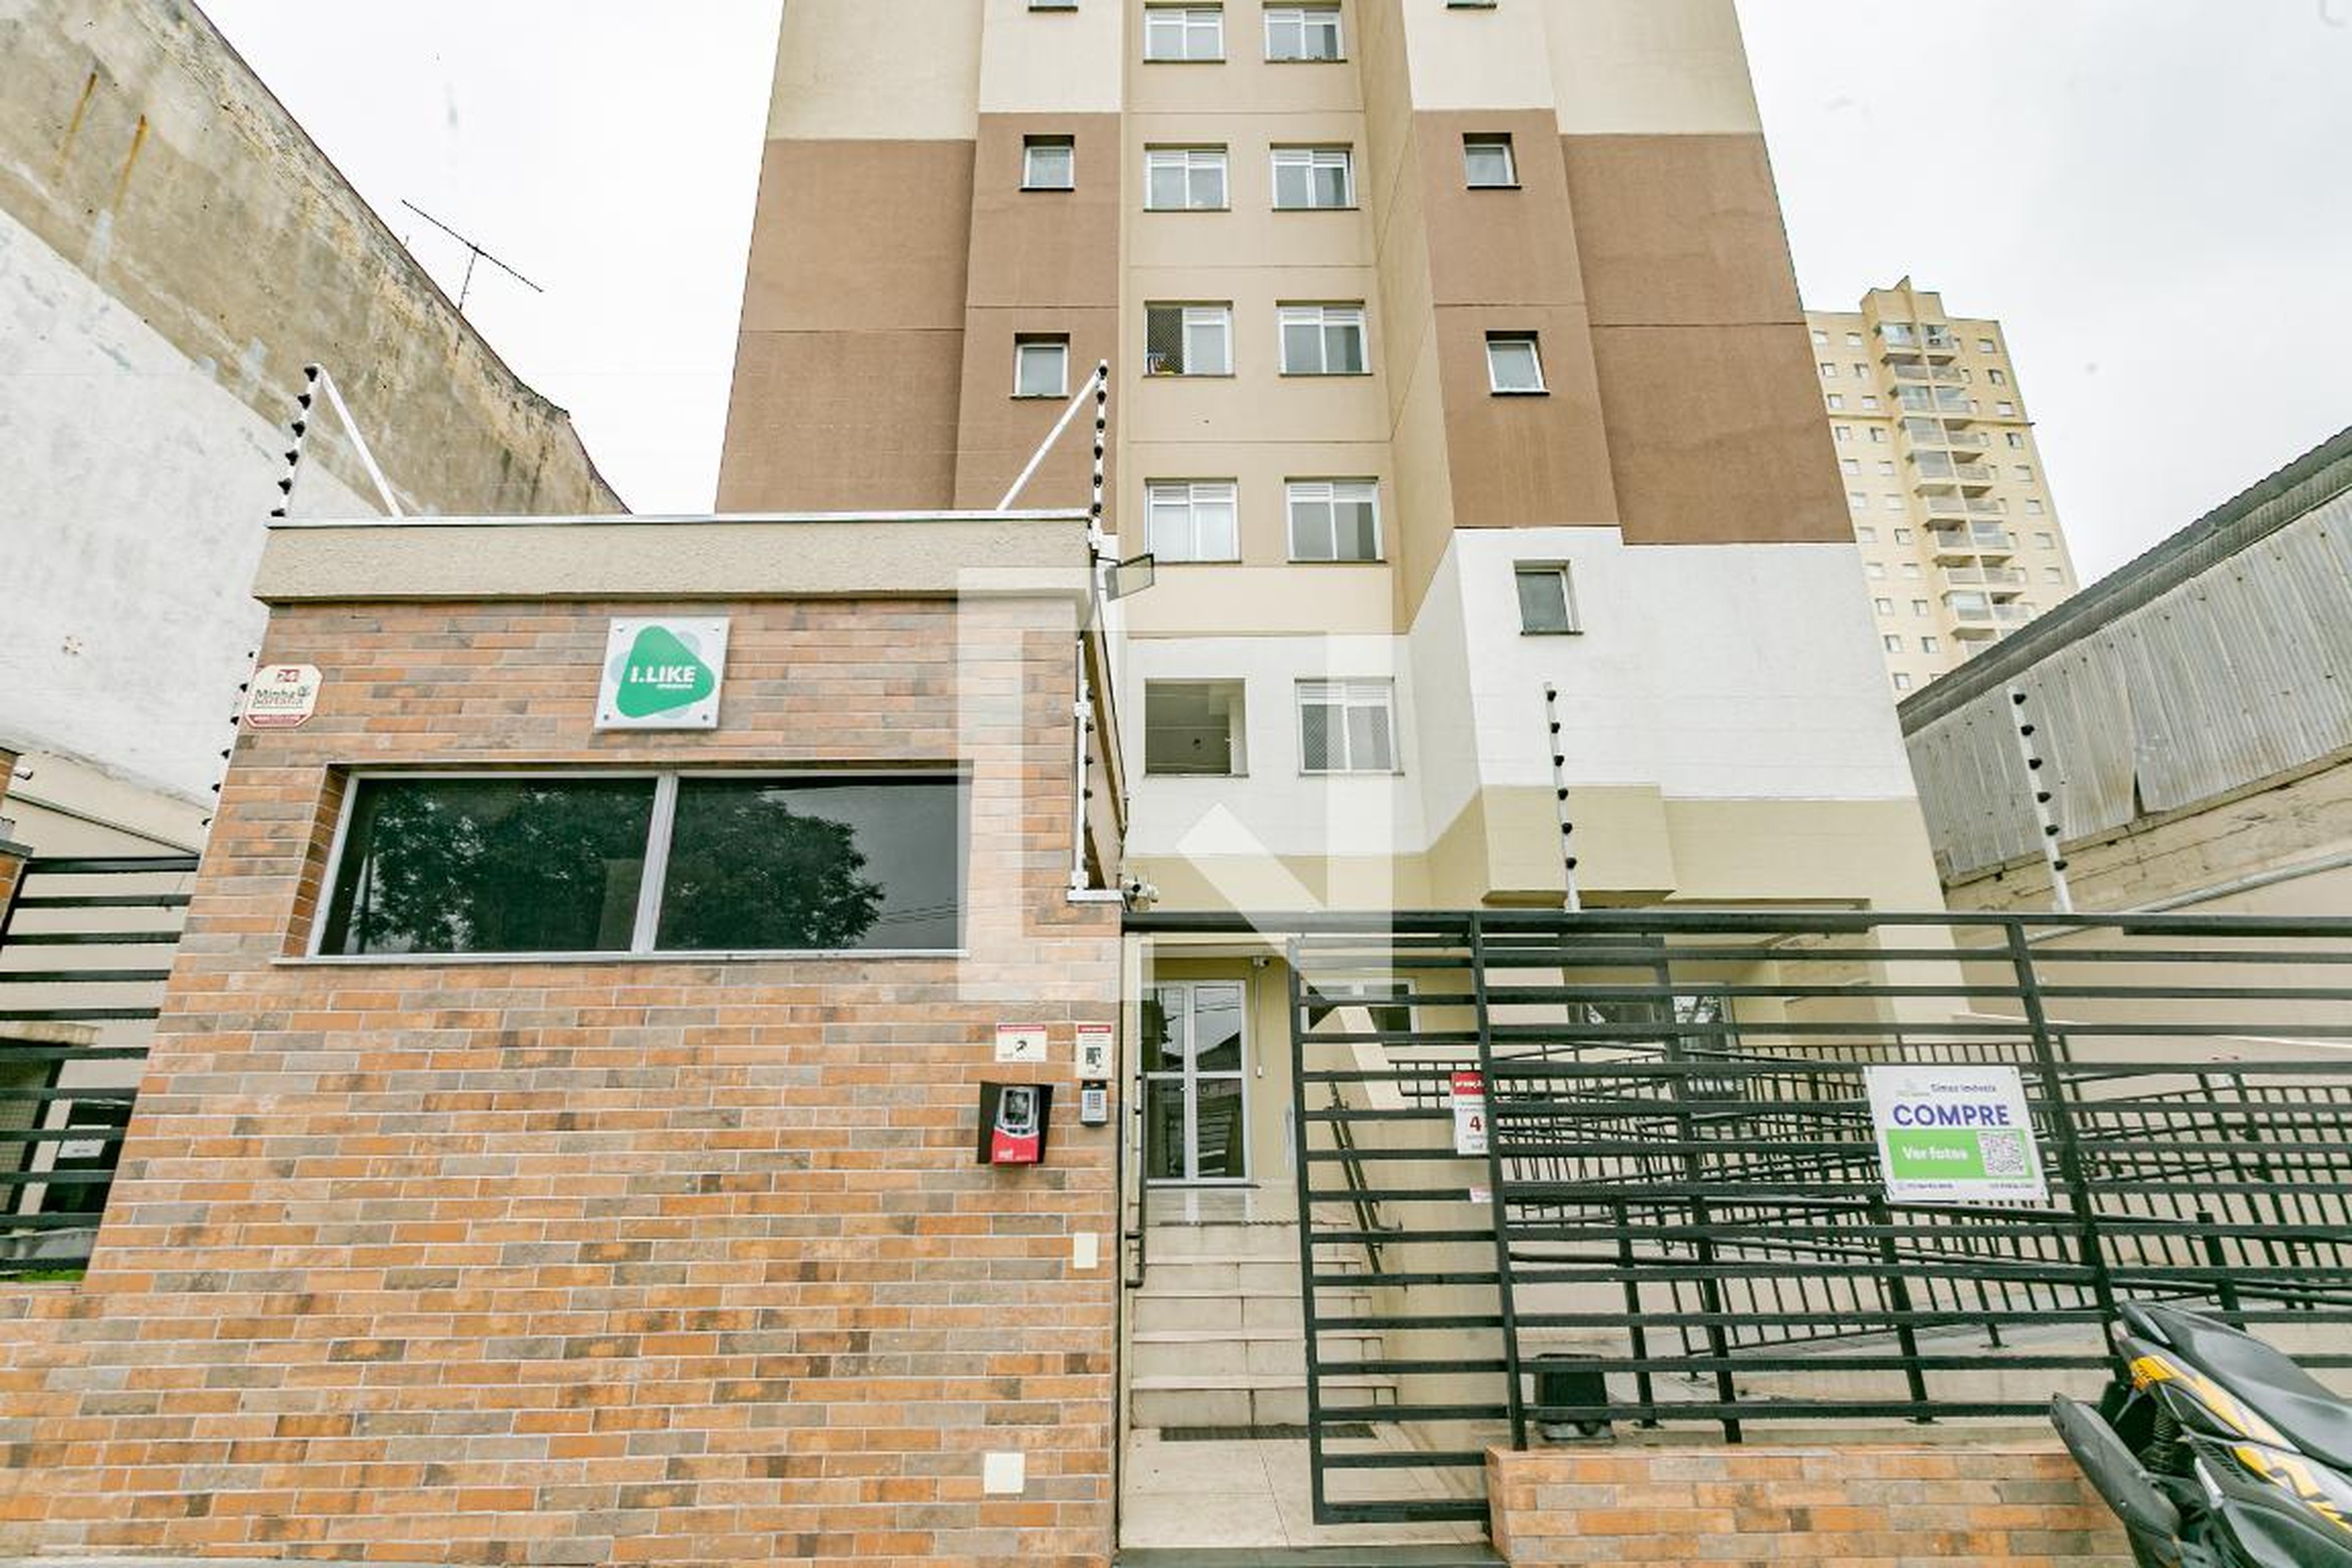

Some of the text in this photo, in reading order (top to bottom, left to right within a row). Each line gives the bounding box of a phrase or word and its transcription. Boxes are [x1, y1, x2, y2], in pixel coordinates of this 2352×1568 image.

[630, 666, 696, 683] I.LIKE
[1893, 1104, 2010, 1126] COMPRE
[1469, 1116, 1482, 1132] 4
[1902, 1145, 1969, 1160] Ver fotos
